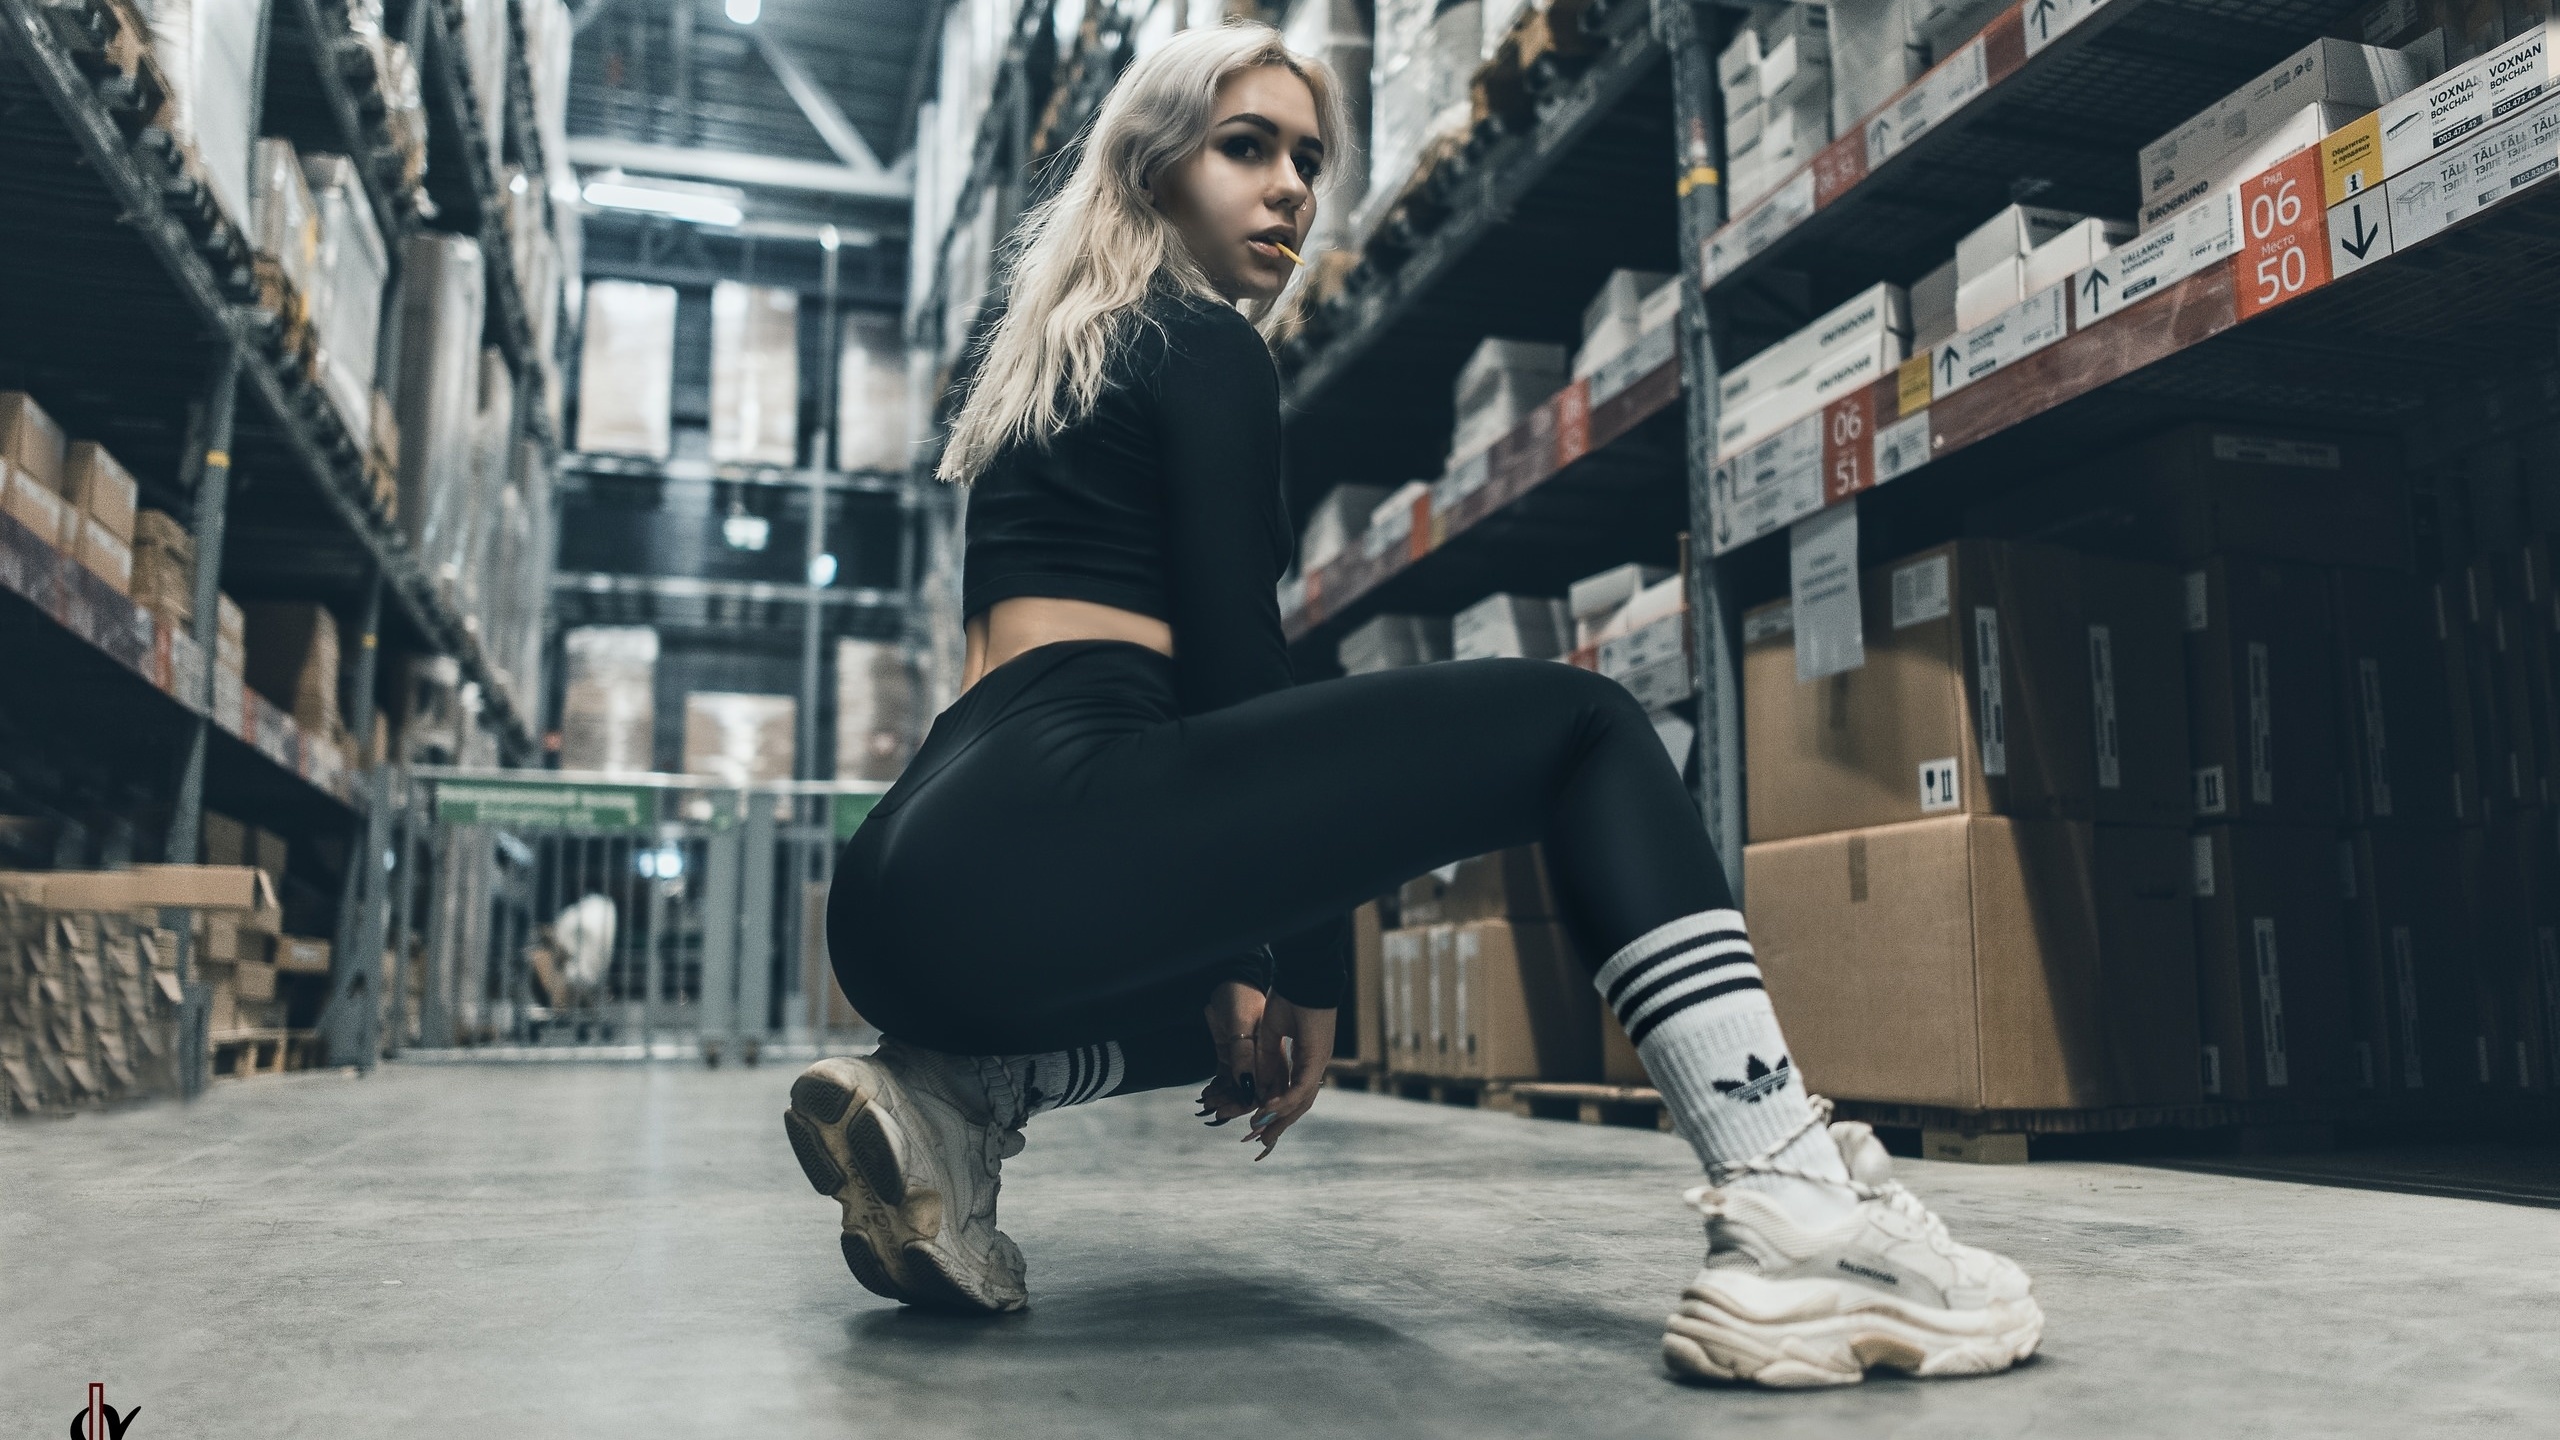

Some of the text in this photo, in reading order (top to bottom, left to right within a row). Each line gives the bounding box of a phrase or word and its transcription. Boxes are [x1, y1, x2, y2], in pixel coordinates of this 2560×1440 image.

[2489, 43, 2542, 77] VOXNAN
[2497, 91, 2537, 114] 003.472.42
[2438, 120, 2477, 144] 003.472.42
[2263, 171, 2284, 188] Ряд
[2517, 161, 2556, 184] 103.838.66
[2147, 180, 2209, 222] BROGRUND
[2251, 179, 2301, 240] 06
[2261, 234, 2295, 255] Место
[2256, 246, 2307, 305] 50
[1833, 402, 1862, 447] 06
[1835, 456, 1862, 496] 51
